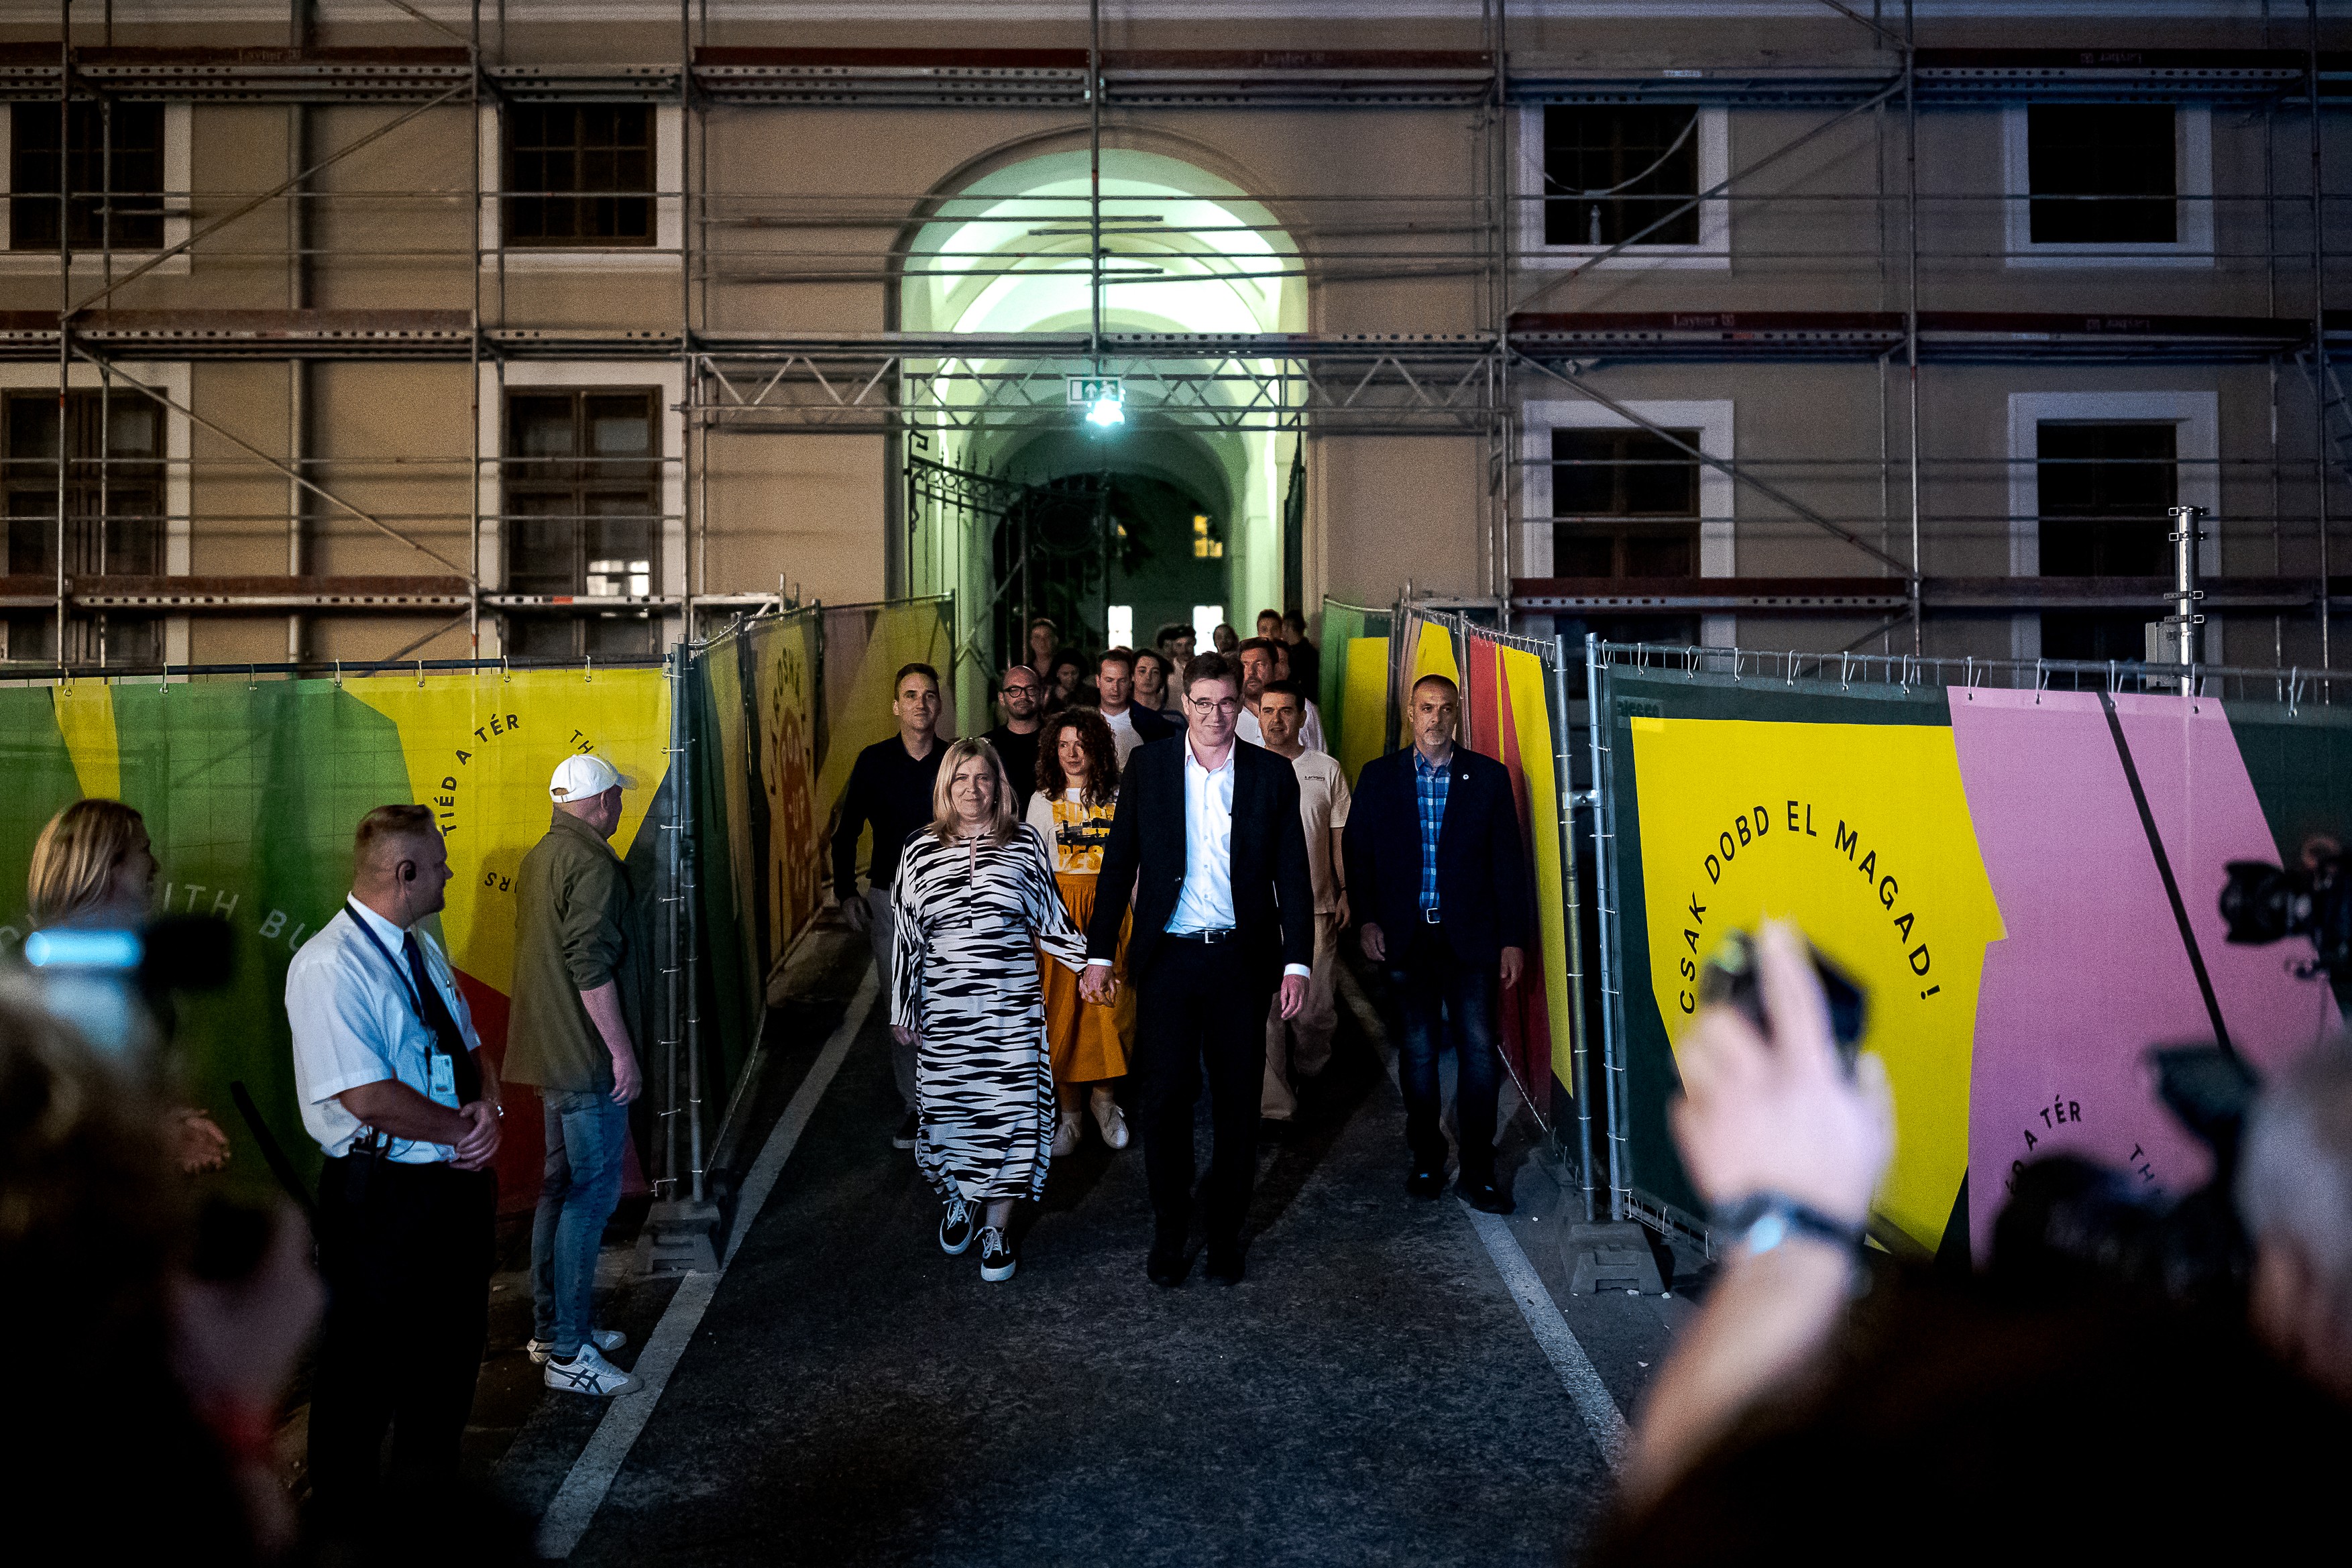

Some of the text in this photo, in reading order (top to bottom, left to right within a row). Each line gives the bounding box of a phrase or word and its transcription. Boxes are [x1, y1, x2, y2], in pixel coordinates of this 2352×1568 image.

[433, 714, 520, 836] TIÉD A TÉR
[569, 729, 595, 754] TH
[1679, 800, 1941, 1014] CSAK DOBD EL MAGAD!
[2023, 1129, 2038, 1152] A
[2039, 1095, 2082, 1129] TÉR
